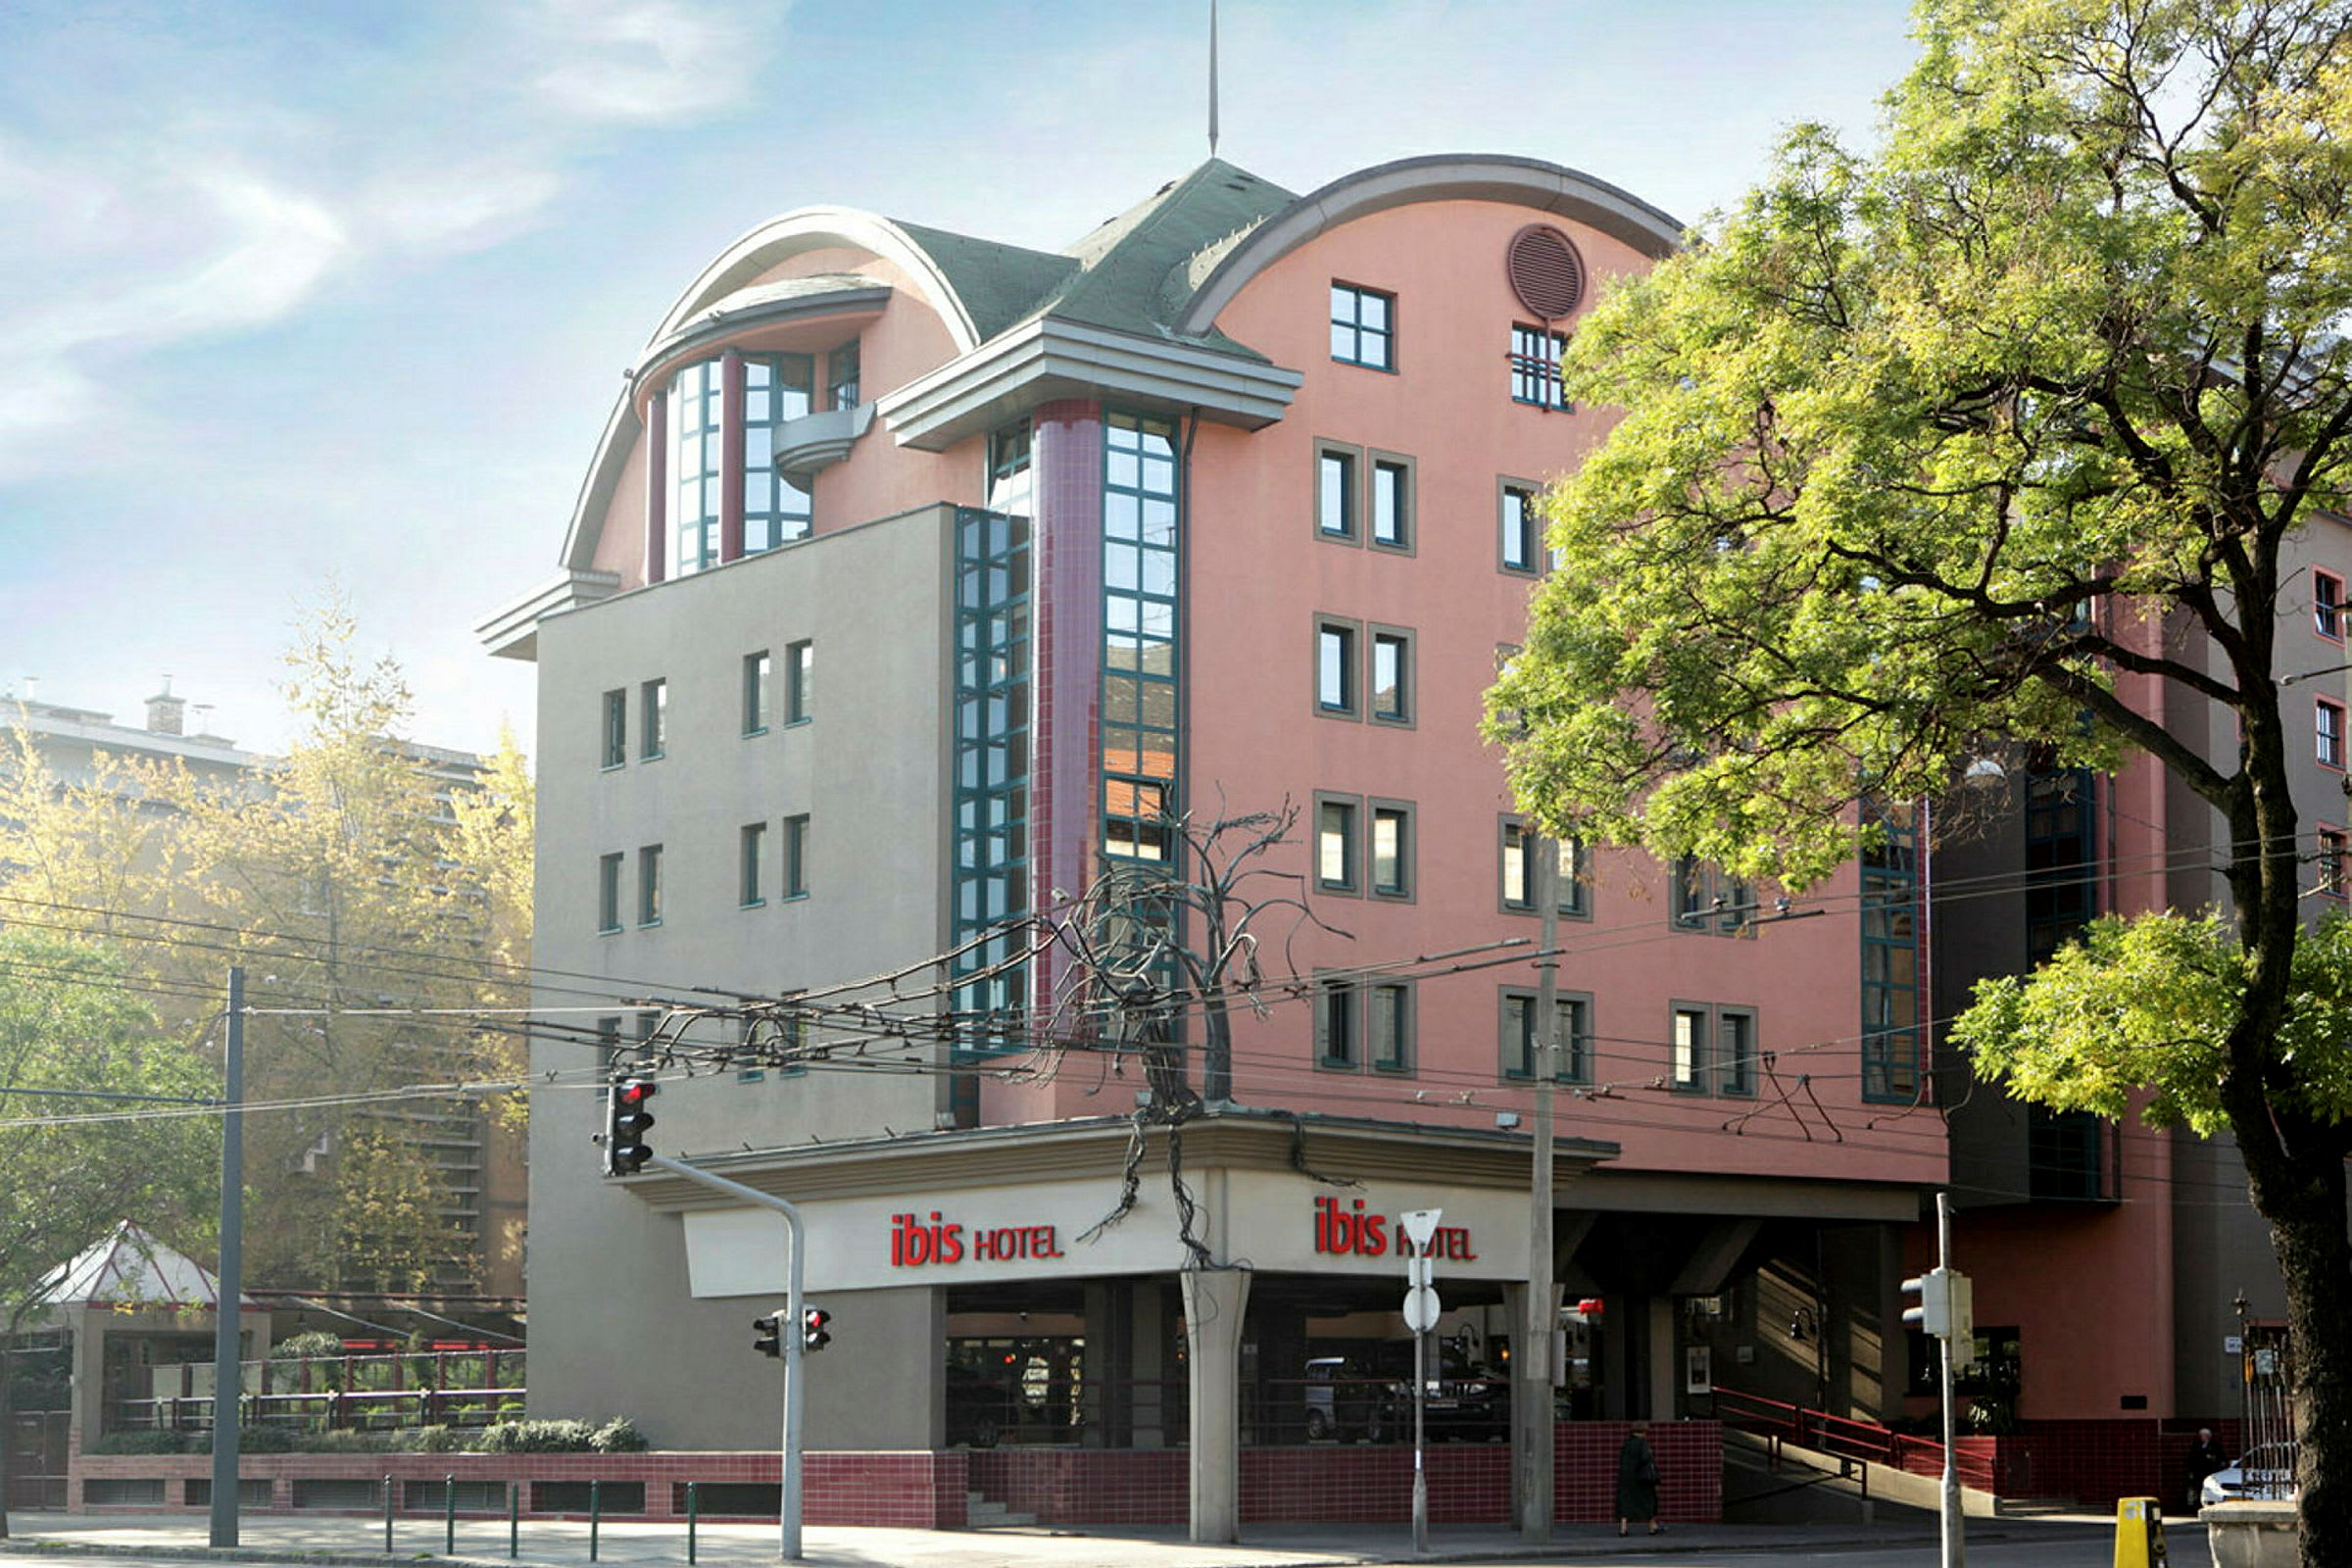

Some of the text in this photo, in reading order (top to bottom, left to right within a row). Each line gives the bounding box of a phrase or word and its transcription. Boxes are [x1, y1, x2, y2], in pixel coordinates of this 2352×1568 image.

[891, 1210, 1065, 1266] ibis HOTEL
[1315, 1196, 1478, 1260] ibis HTEL
